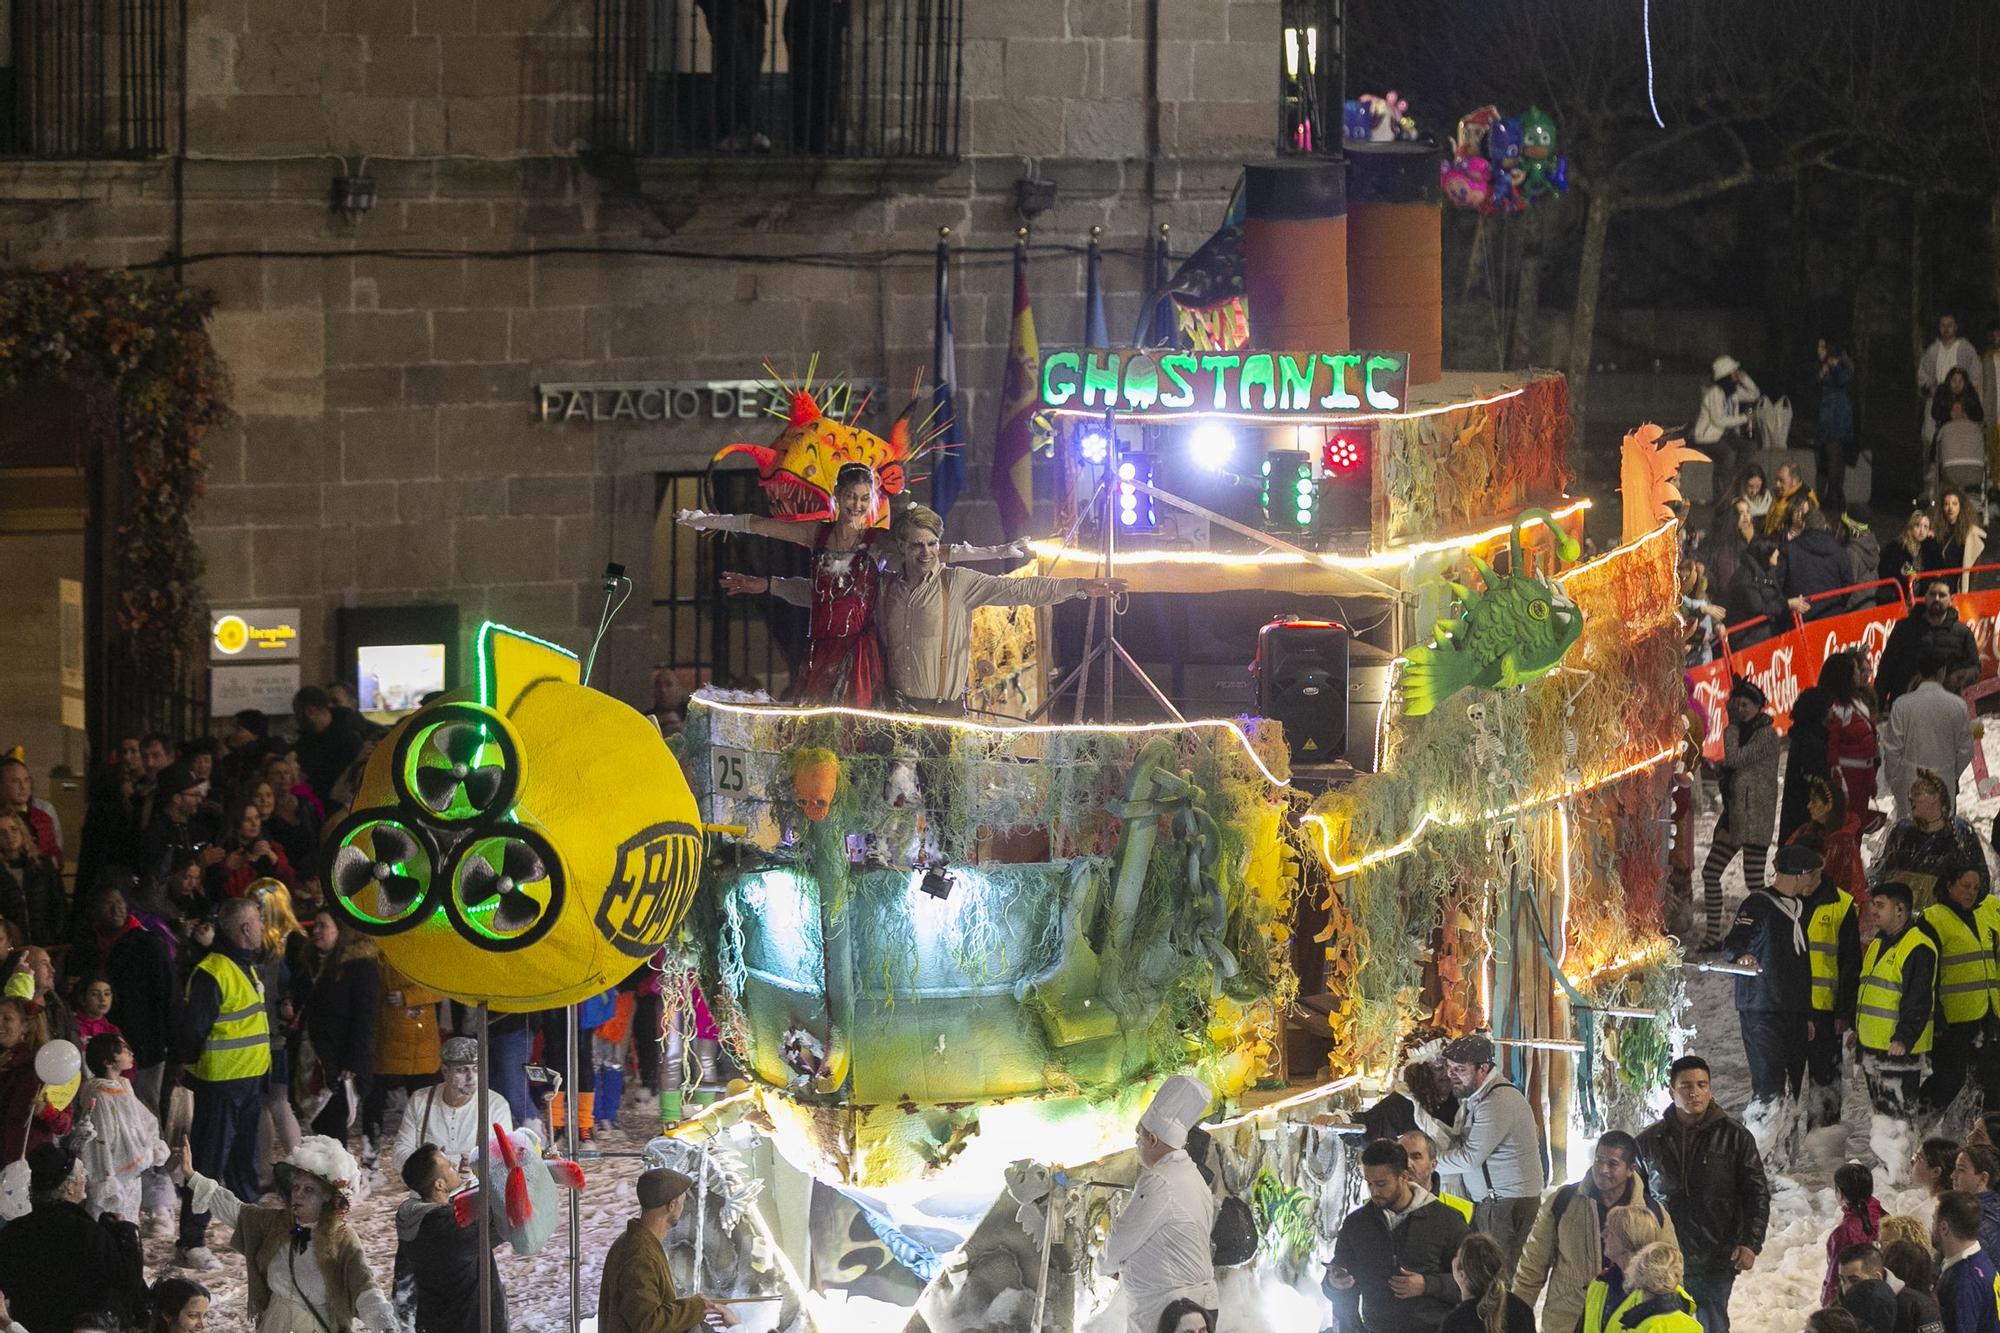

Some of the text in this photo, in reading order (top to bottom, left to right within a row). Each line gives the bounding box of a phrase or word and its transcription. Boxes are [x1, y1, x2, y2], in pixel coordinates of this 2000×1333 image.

[1042, 352, 1400, 411] GHOSTANIC
[541, 389, 700, 421] PALACIO
[712, 388, 759, 418] DE
[718, 755, 744, 792] 25
